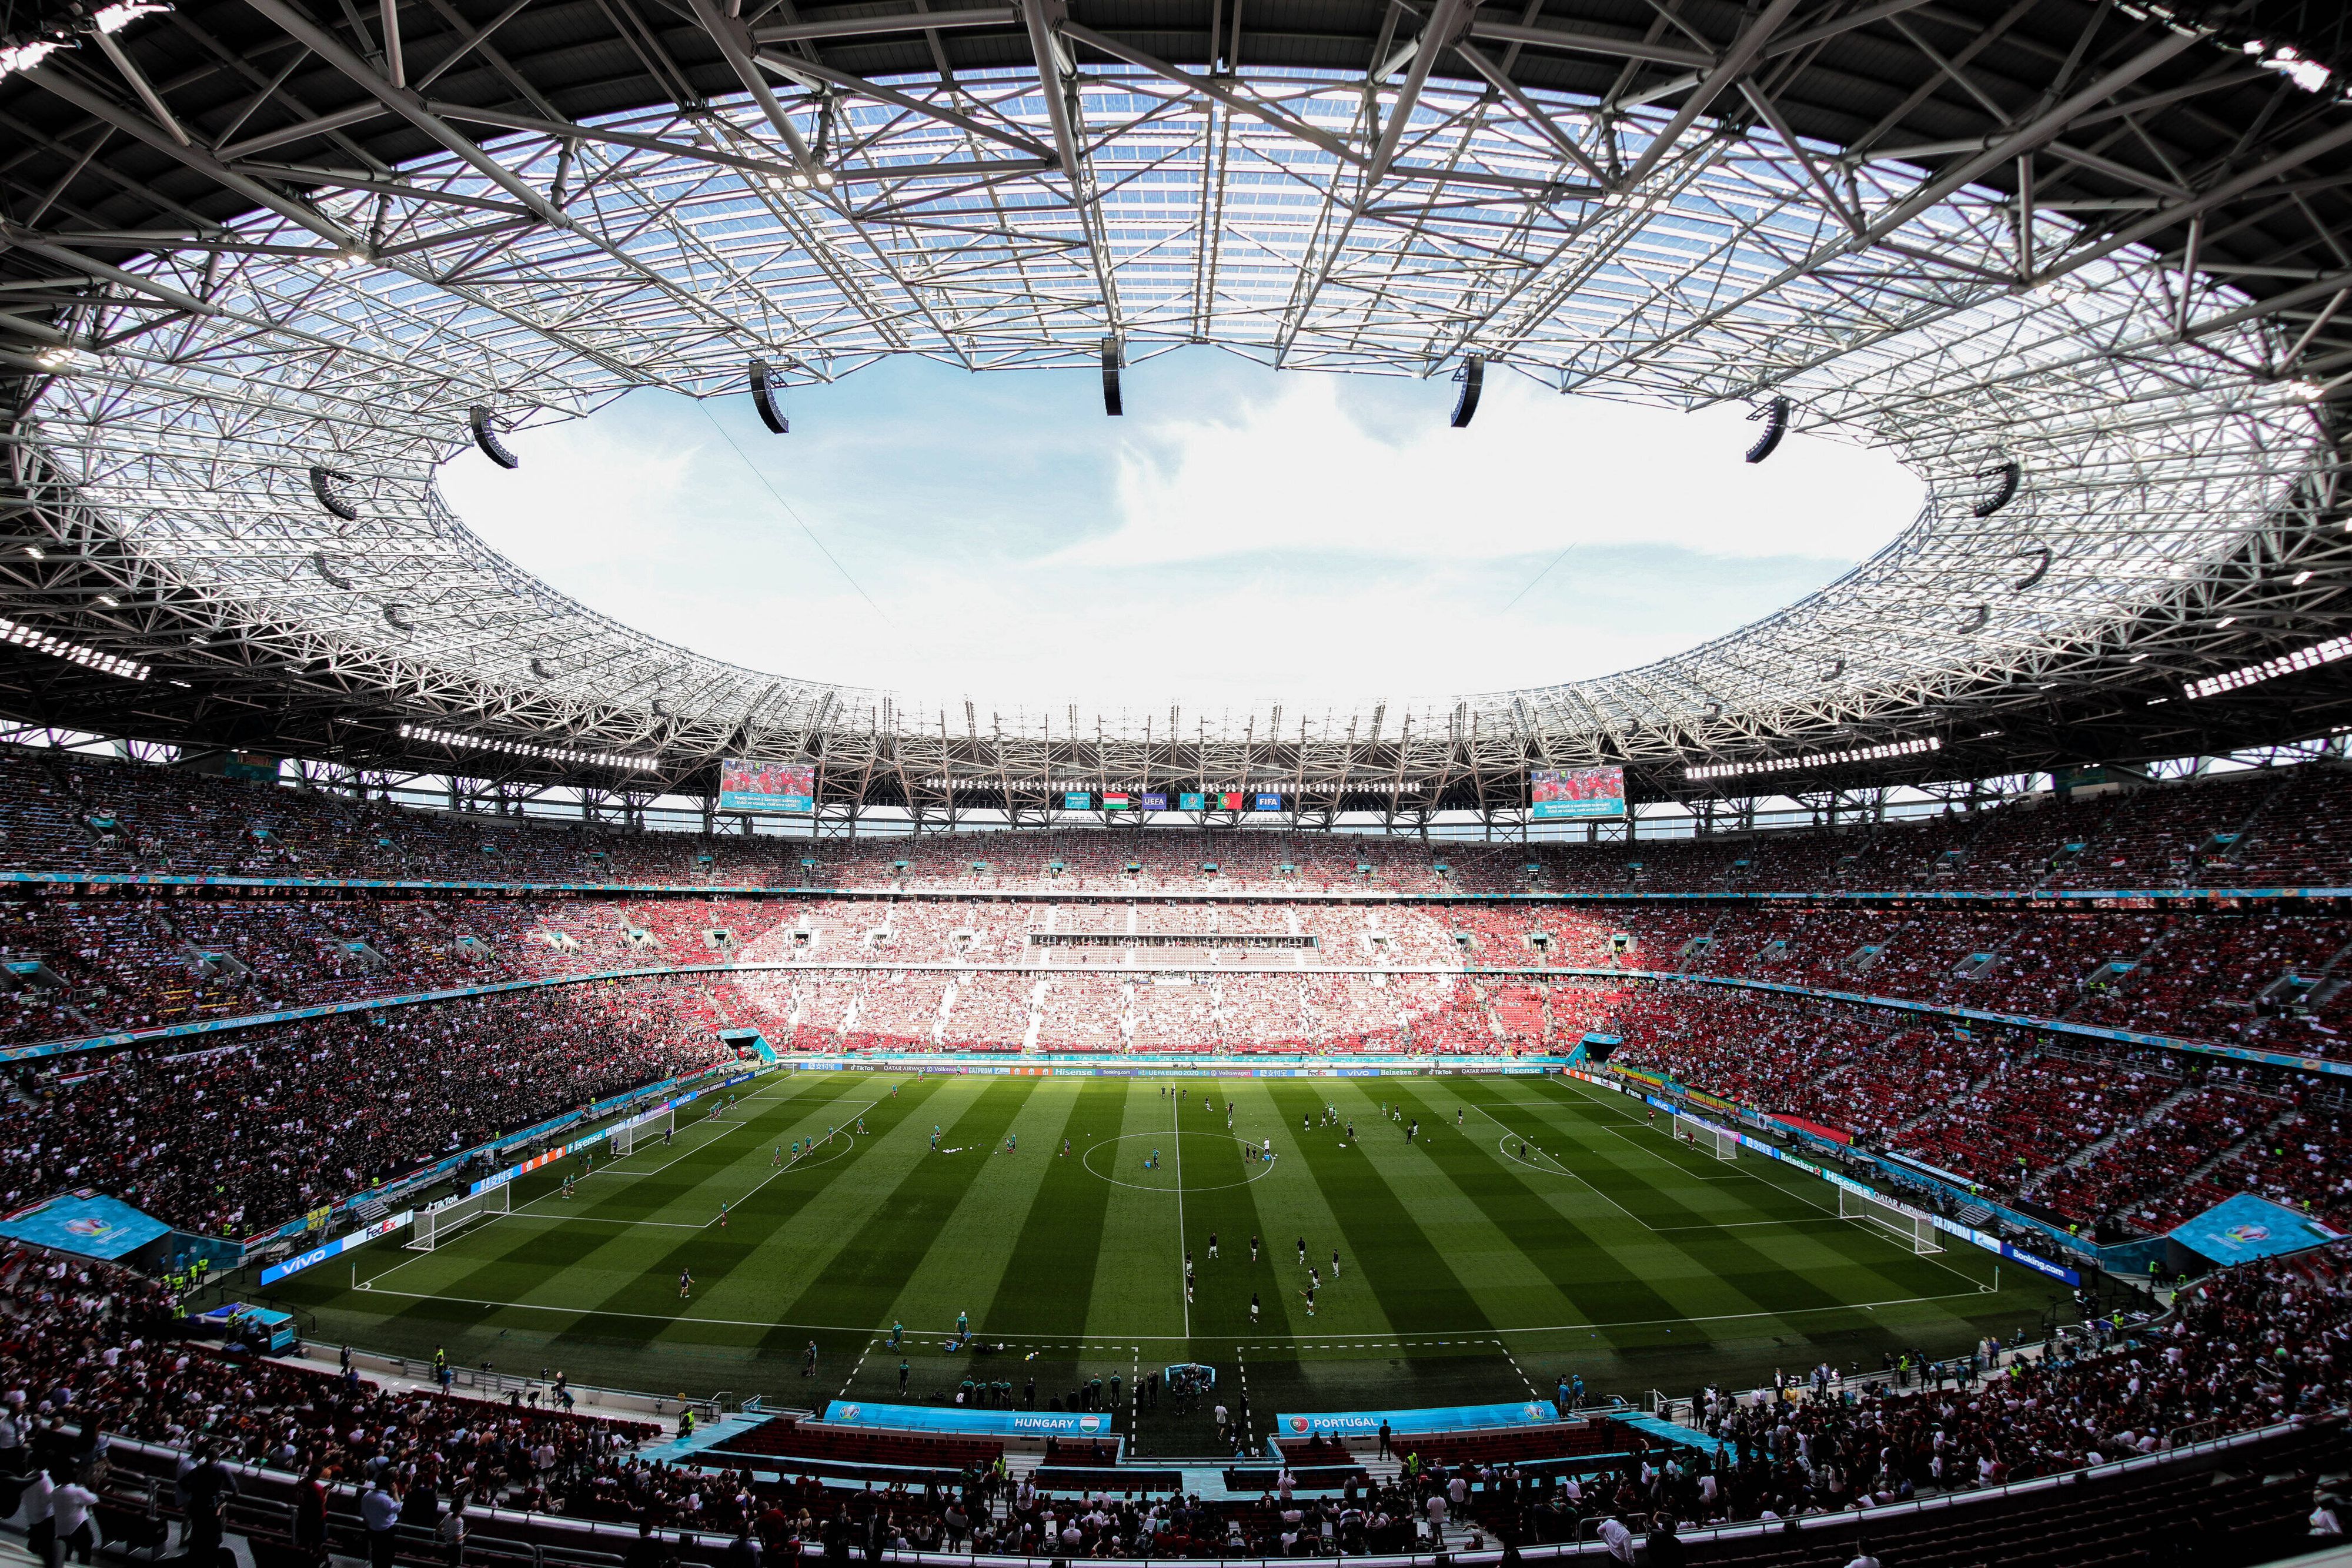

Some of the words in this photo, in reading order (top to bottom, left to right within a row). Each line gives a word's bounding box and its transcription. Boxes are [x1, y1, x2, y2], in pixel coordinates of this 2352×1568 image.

[342, 1002, 372, 1011] BUDAPEST
[754, 1066, 775, 1077] Heineken
[730, 1075, 749, 1084] Booking.com
[1601, 1078, 1614, 1089] FedEx
[696, 1087, 709, 1096] QATAR
[709, 1081, 726, 1093] AIRWAYS
[1630, 1089, 1642, 1099] TikTok
[568, 1132, 603, 1153] Hisense
[1780, 1152, 1814, 1174] Heineken
[1826, 1169, 1870, 1197] Hisense
[433, 1193, 459, 1210] TikTok
[1874, 1191, 1898, 1207] QATAR
[1899, 1201, 1932, 1221] AIRWAYS
[366, 1219, 397, 1240] FedEx
[1934, 1215, 1970, 1241] GAZPROM
[2013, 1249, 2066, 1278] Booking.com
[1014, 1417, 1074, 1429] HUNGARY
[1314, 1417, 1379, 1429] PORTUGAL
[1266, 1499, 1271, 1509] 8
